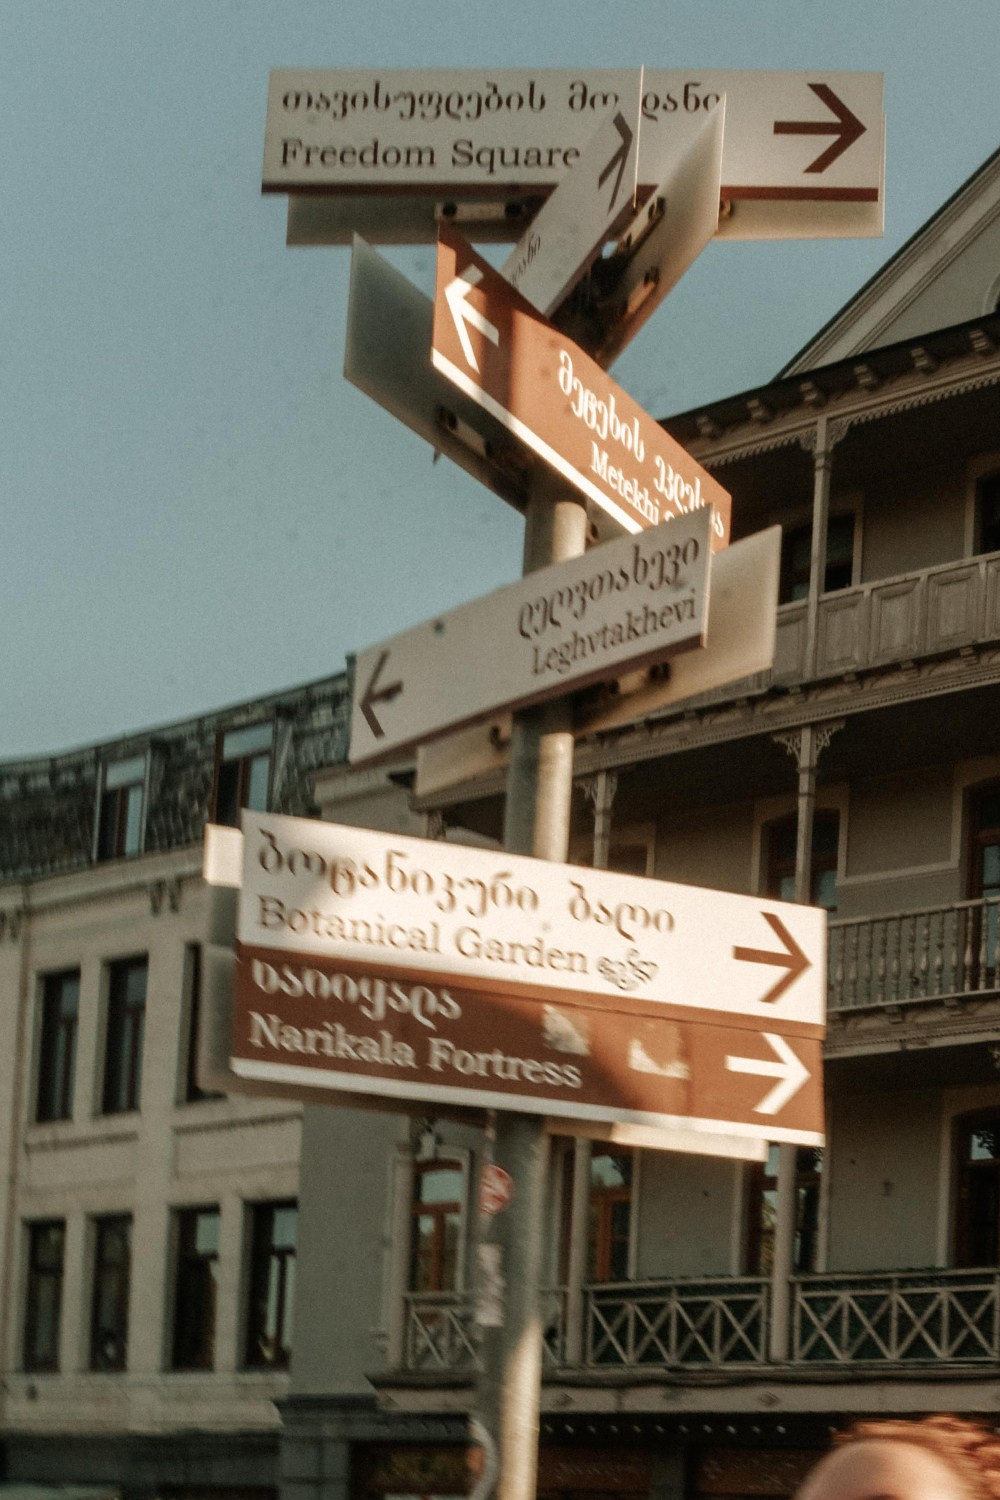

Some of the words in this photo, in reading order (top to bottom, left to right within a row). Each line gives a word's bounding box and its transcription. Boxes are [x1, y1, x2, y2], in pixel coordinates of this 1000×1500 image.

[569, 80, 720, 122] მოდანი
[280, 137, 437, 169] Freedom
[451, 138, 581, 175] Square
[591, 440, 659, 526] Metekhi
[532, 588, 697, 675] Leghvtakhevi
[257, 894, 442, 954] Botanical
[454, 926, 589, 975] Garden
[248, 1010, 419, 1069] Narikala
[427, 1036, 583, 1089] Fortress
